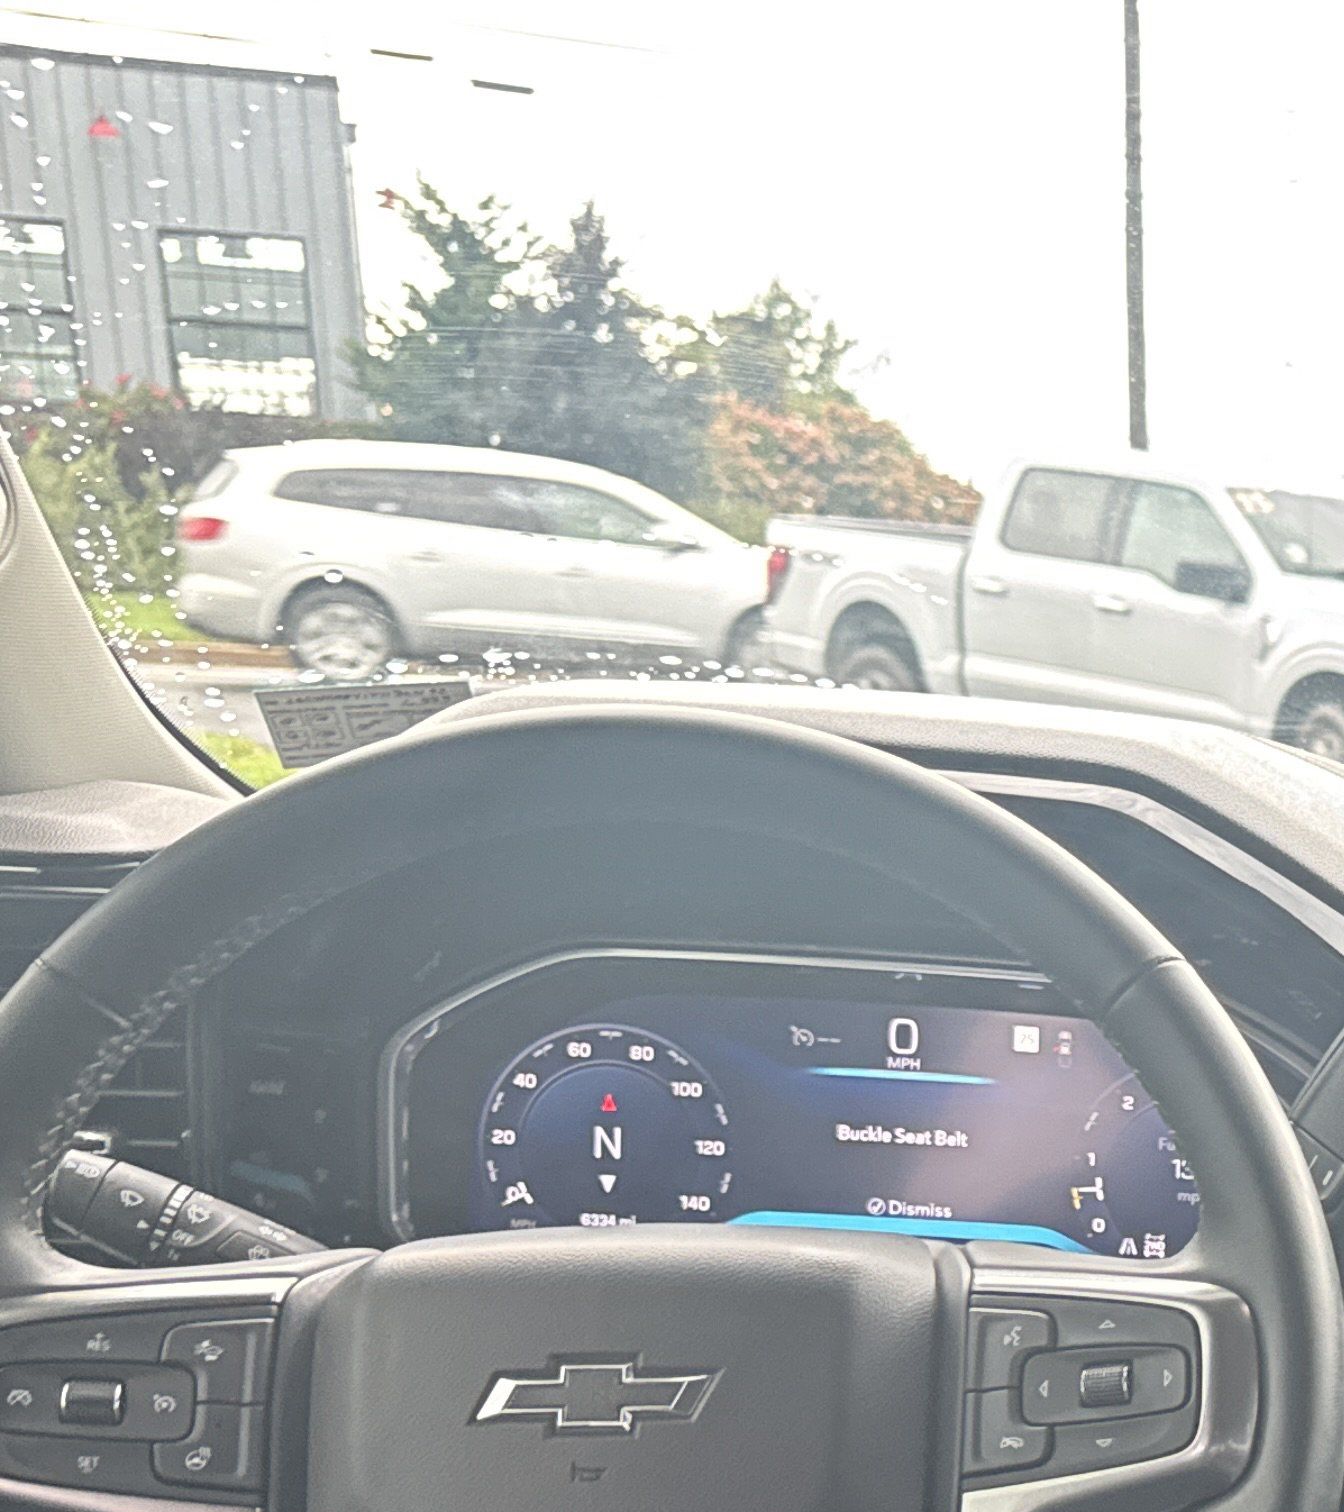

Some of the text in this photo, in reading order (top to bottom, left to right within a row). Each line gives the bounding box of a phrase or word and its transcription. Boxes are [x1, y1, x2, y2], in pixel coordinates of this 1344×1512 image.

[889, 1018, 919, 1055] 0
[567, 1041, 592, 1058] 60
[629, 1045, 655, 1062] 80
[886, 1056, 921, 1071] MPH
[513, 1072, 538, 1089] 40
[670, 1081, 703, 1098] 100
[1121, 1096, 1135, 1111] 2
[491, 1128, 517, 1145] 20
[593, 1125, 622, 1160] N
[835, 1123, 969, 1148] Buckle Seat Belt
[694, 1139, 726, 1157] 120
[1086, 1152, 1096, 1167] 1
[678, 1194, 711, 1212] 140
[887, 1200, 953, 1219] Dismiss
[579, 1213, 637, 1227] 6334 mi
[1091, 1217, 1106, 1233] 0
